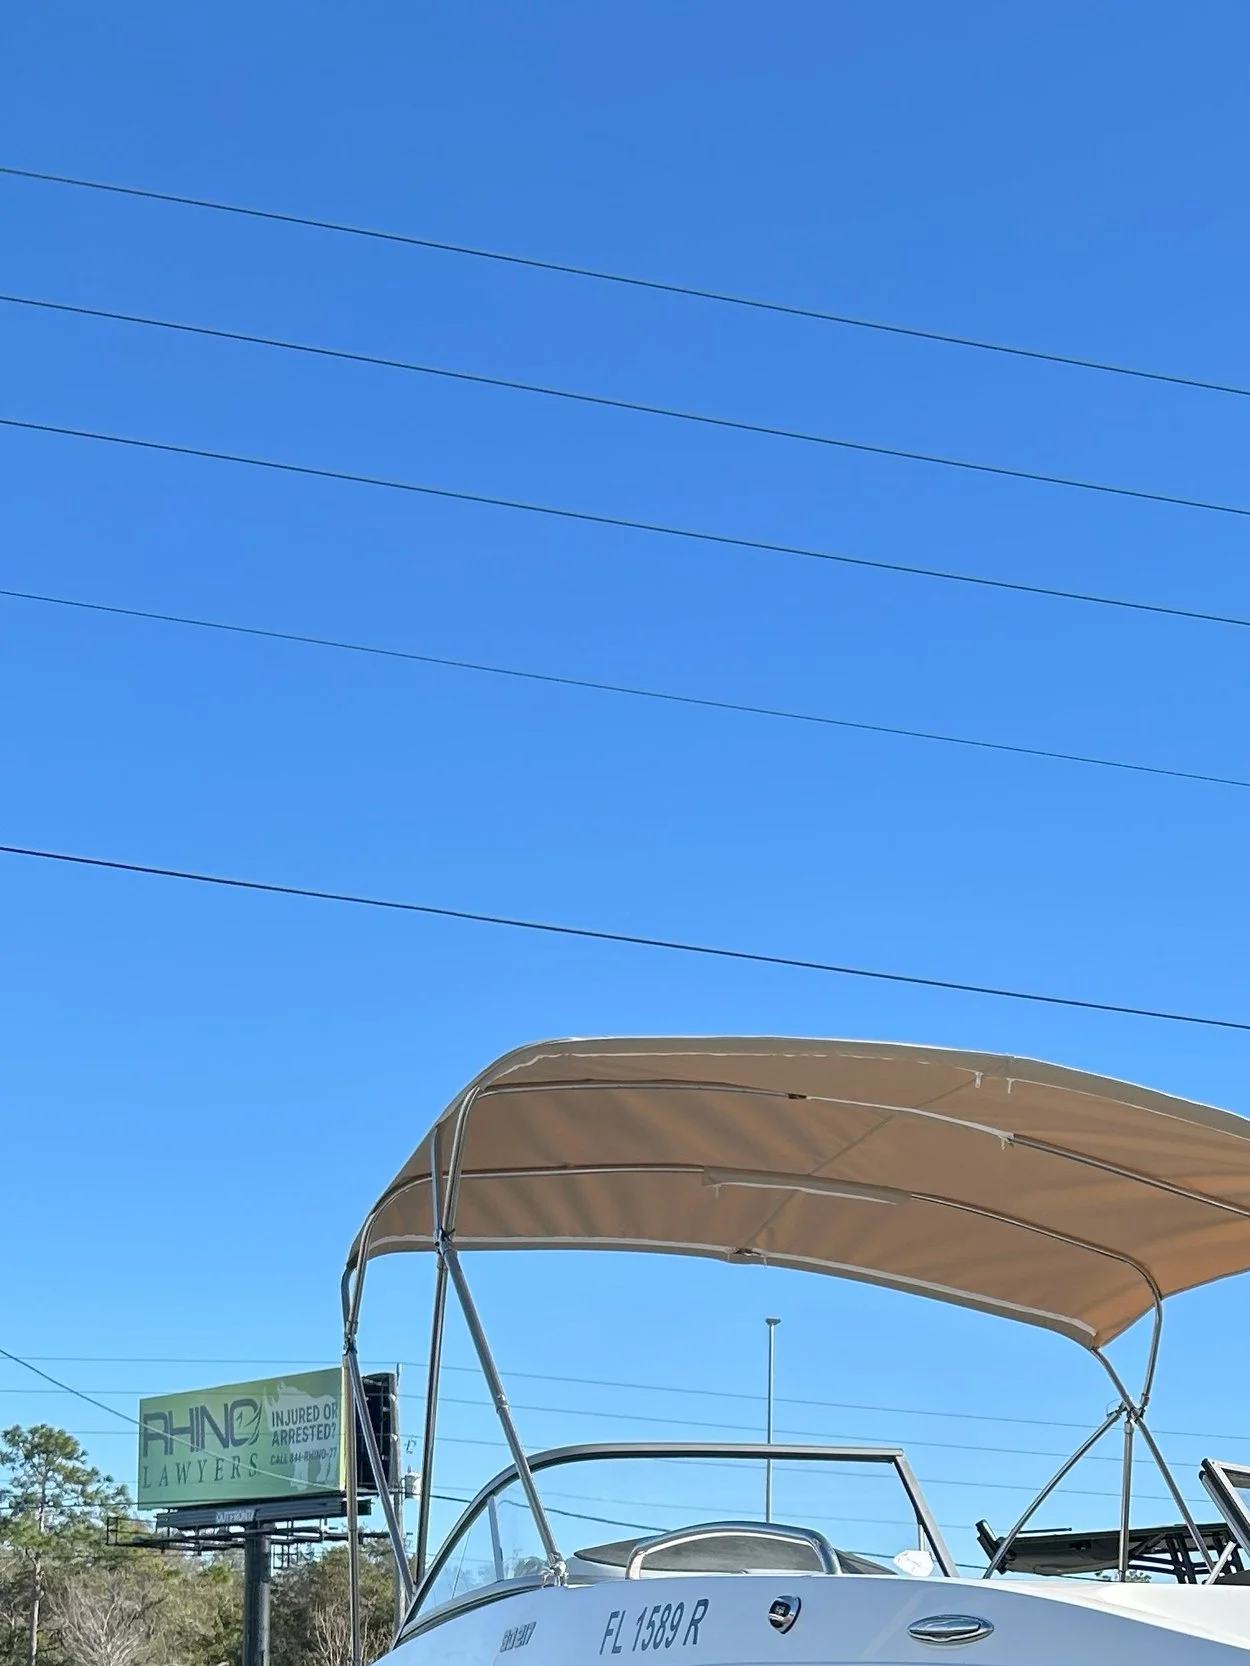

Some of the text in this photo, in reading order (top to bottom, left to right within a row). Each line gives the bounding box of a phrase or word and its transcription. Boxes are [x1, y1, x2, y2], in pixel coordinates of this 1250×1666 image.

[142, 1398, 263, 1458] RHINO
[271, 1402, 338, 1428] INJURED OR
[271, 1421, 337, 1448] ARRESTED?
[142, 1452, 259, 1489] LAWYERS
[270, 1453, 288, 1466] CALL
[600, 1598, 709, 1656] FL 1589 R
